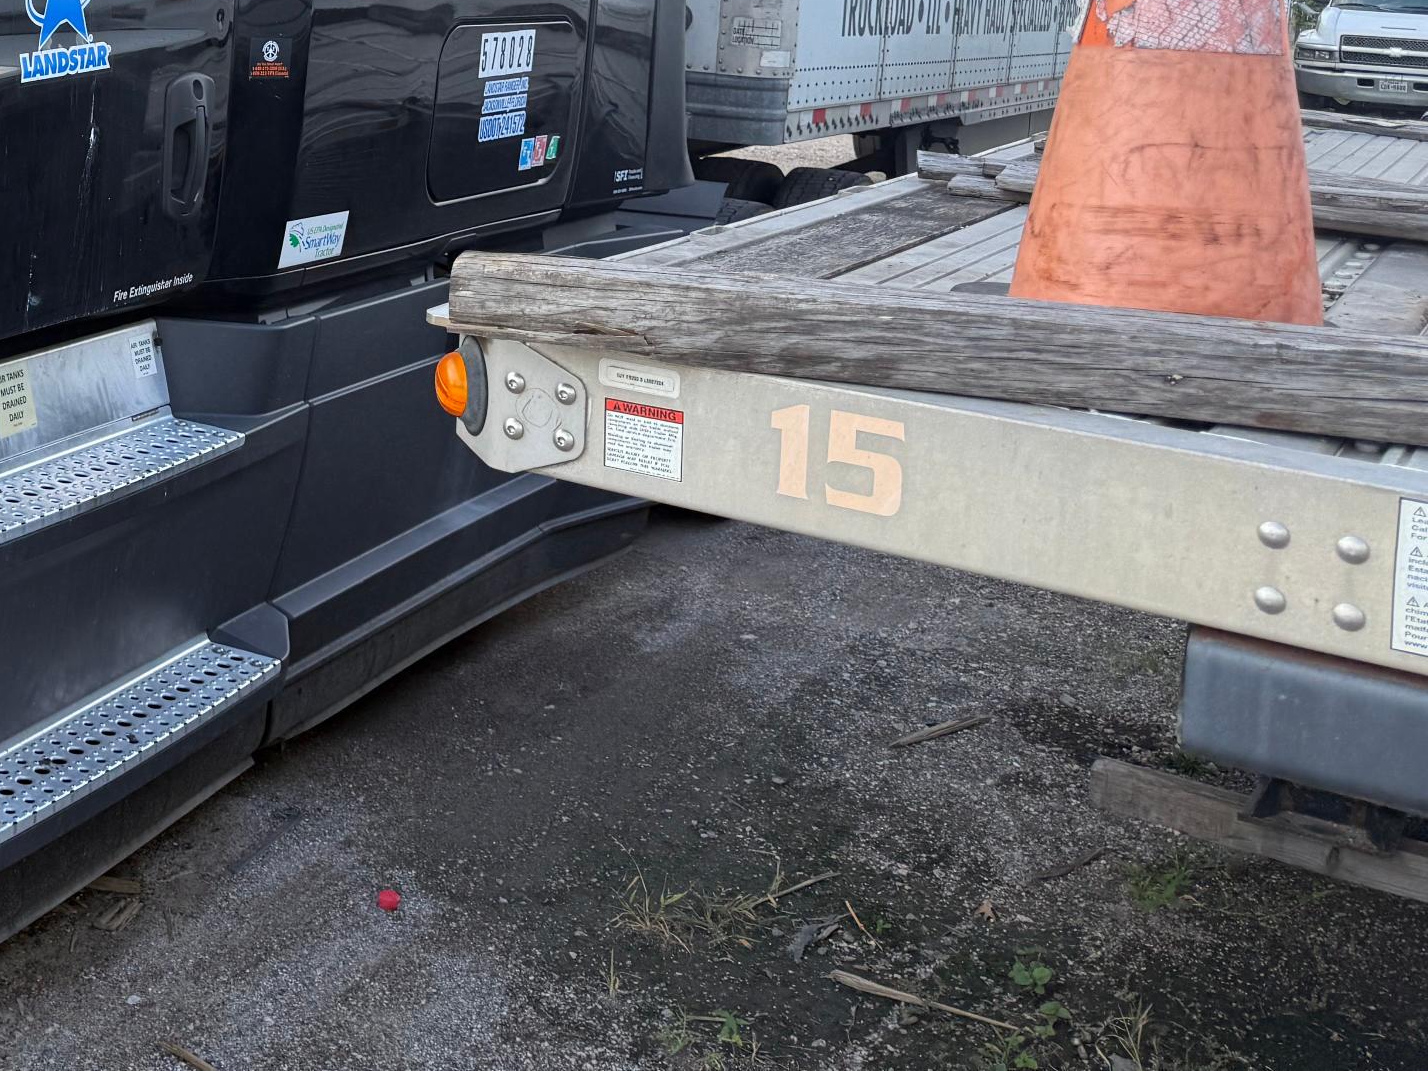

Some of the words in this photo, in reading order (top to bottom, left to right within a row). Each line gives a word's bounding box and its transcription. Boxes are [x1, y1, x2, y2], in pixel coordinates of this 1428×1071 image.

[20, 43, 110, 81] LANDSTAR
[481, 35, 534, 72] 578028
[304, 232, 341, 250] SmartWay
[315, 248, 334, 258] Tractor
[113, 289, 128, 303] Fire
[129, 279, 172, 298] Extinguisher
[173, 272, 193, 287] Inside
[6, 369, 24, 381] TANKS
[0, 385, 16, 397] MUST
[17, 382, 25, 392] BE
[2, 395, 27, 410] DRAINED
[9, 411, 24, 422] DAILY
[623, 403, 677, 421] WARNING
[771, 404, 905, 517] 15
